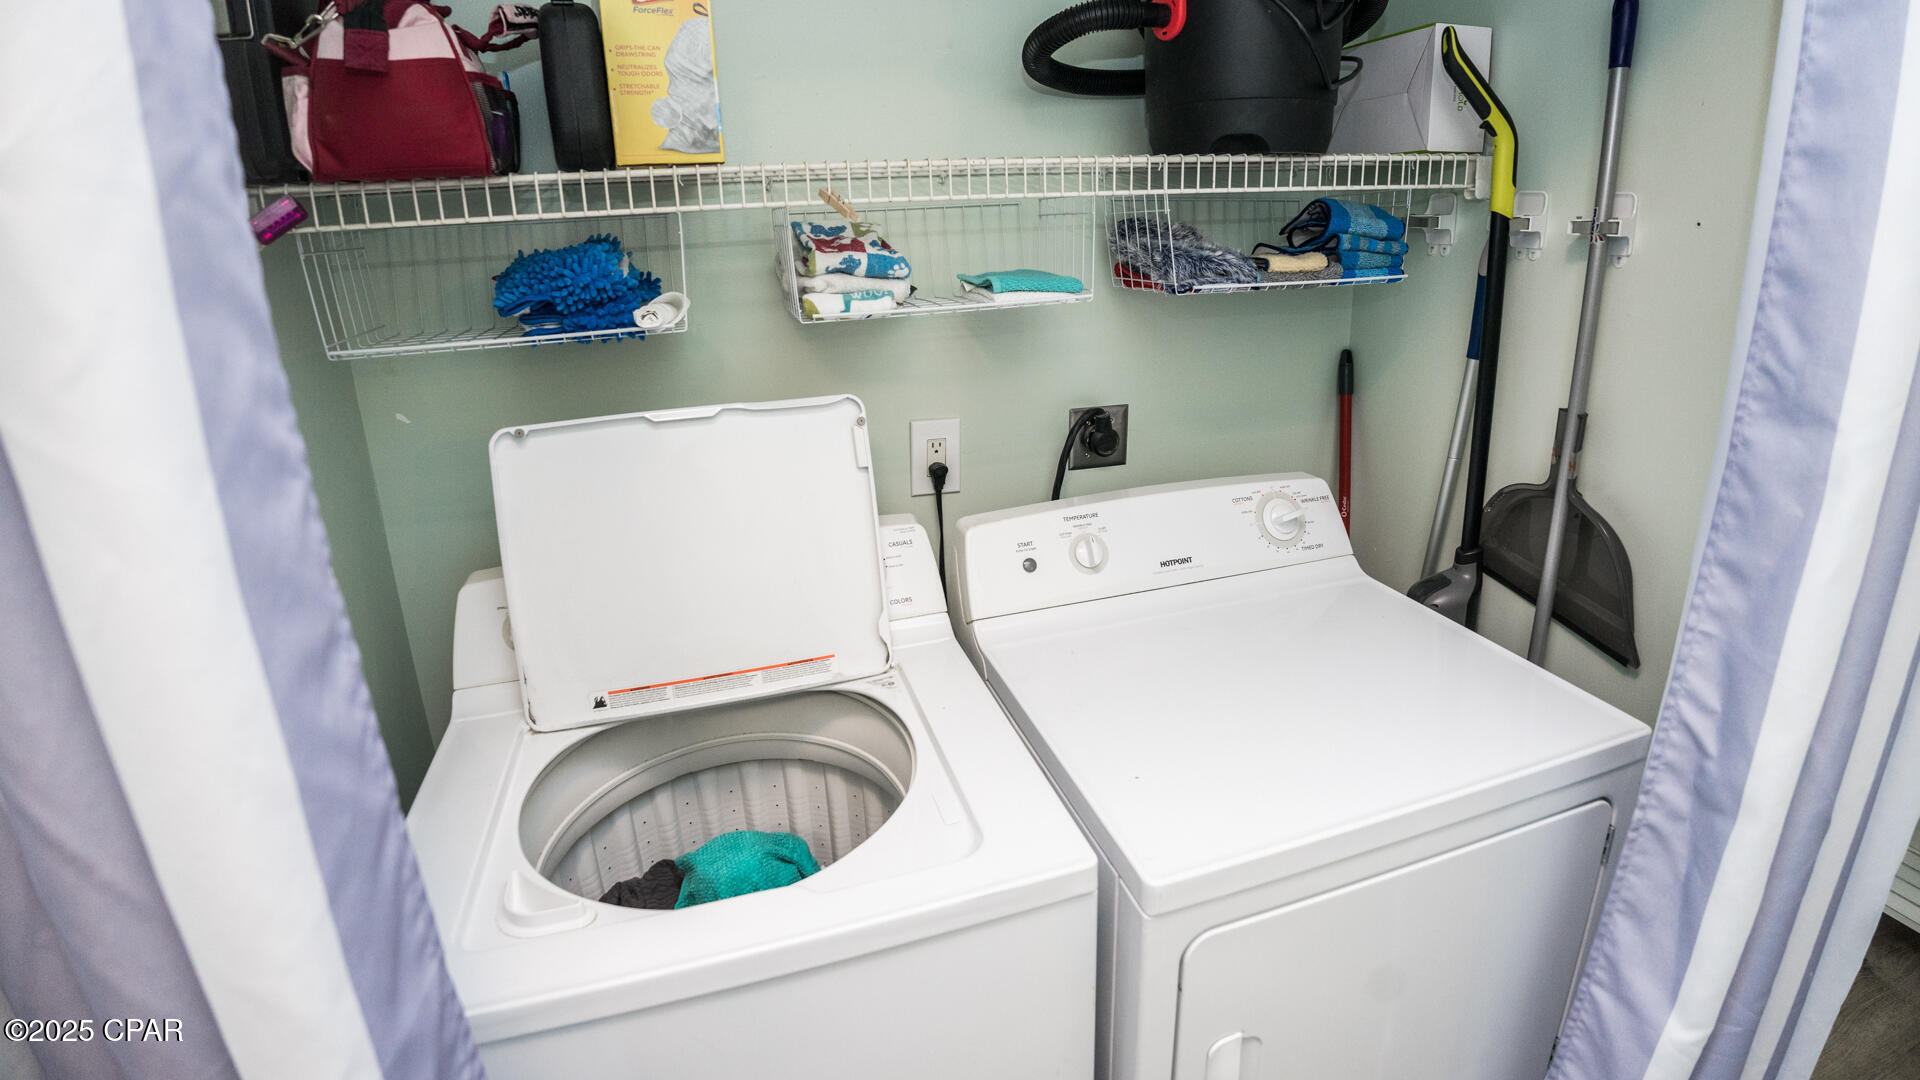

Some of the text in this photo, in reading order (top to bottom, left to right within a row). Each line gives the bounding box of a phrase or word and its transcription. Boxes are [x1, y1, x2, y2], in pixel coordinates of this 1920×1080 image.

[632, 5, 673, 15] ForceFlex
[1231, 495, 1254, 504] COTTONS
[1062, 512, 1099, 522] TEMPERATURE
[887, 539, 913, 548] CASUALS
[1160, 556, 1193, 568] HOTPOINT
[889, 596, 913, 605] COLORS
